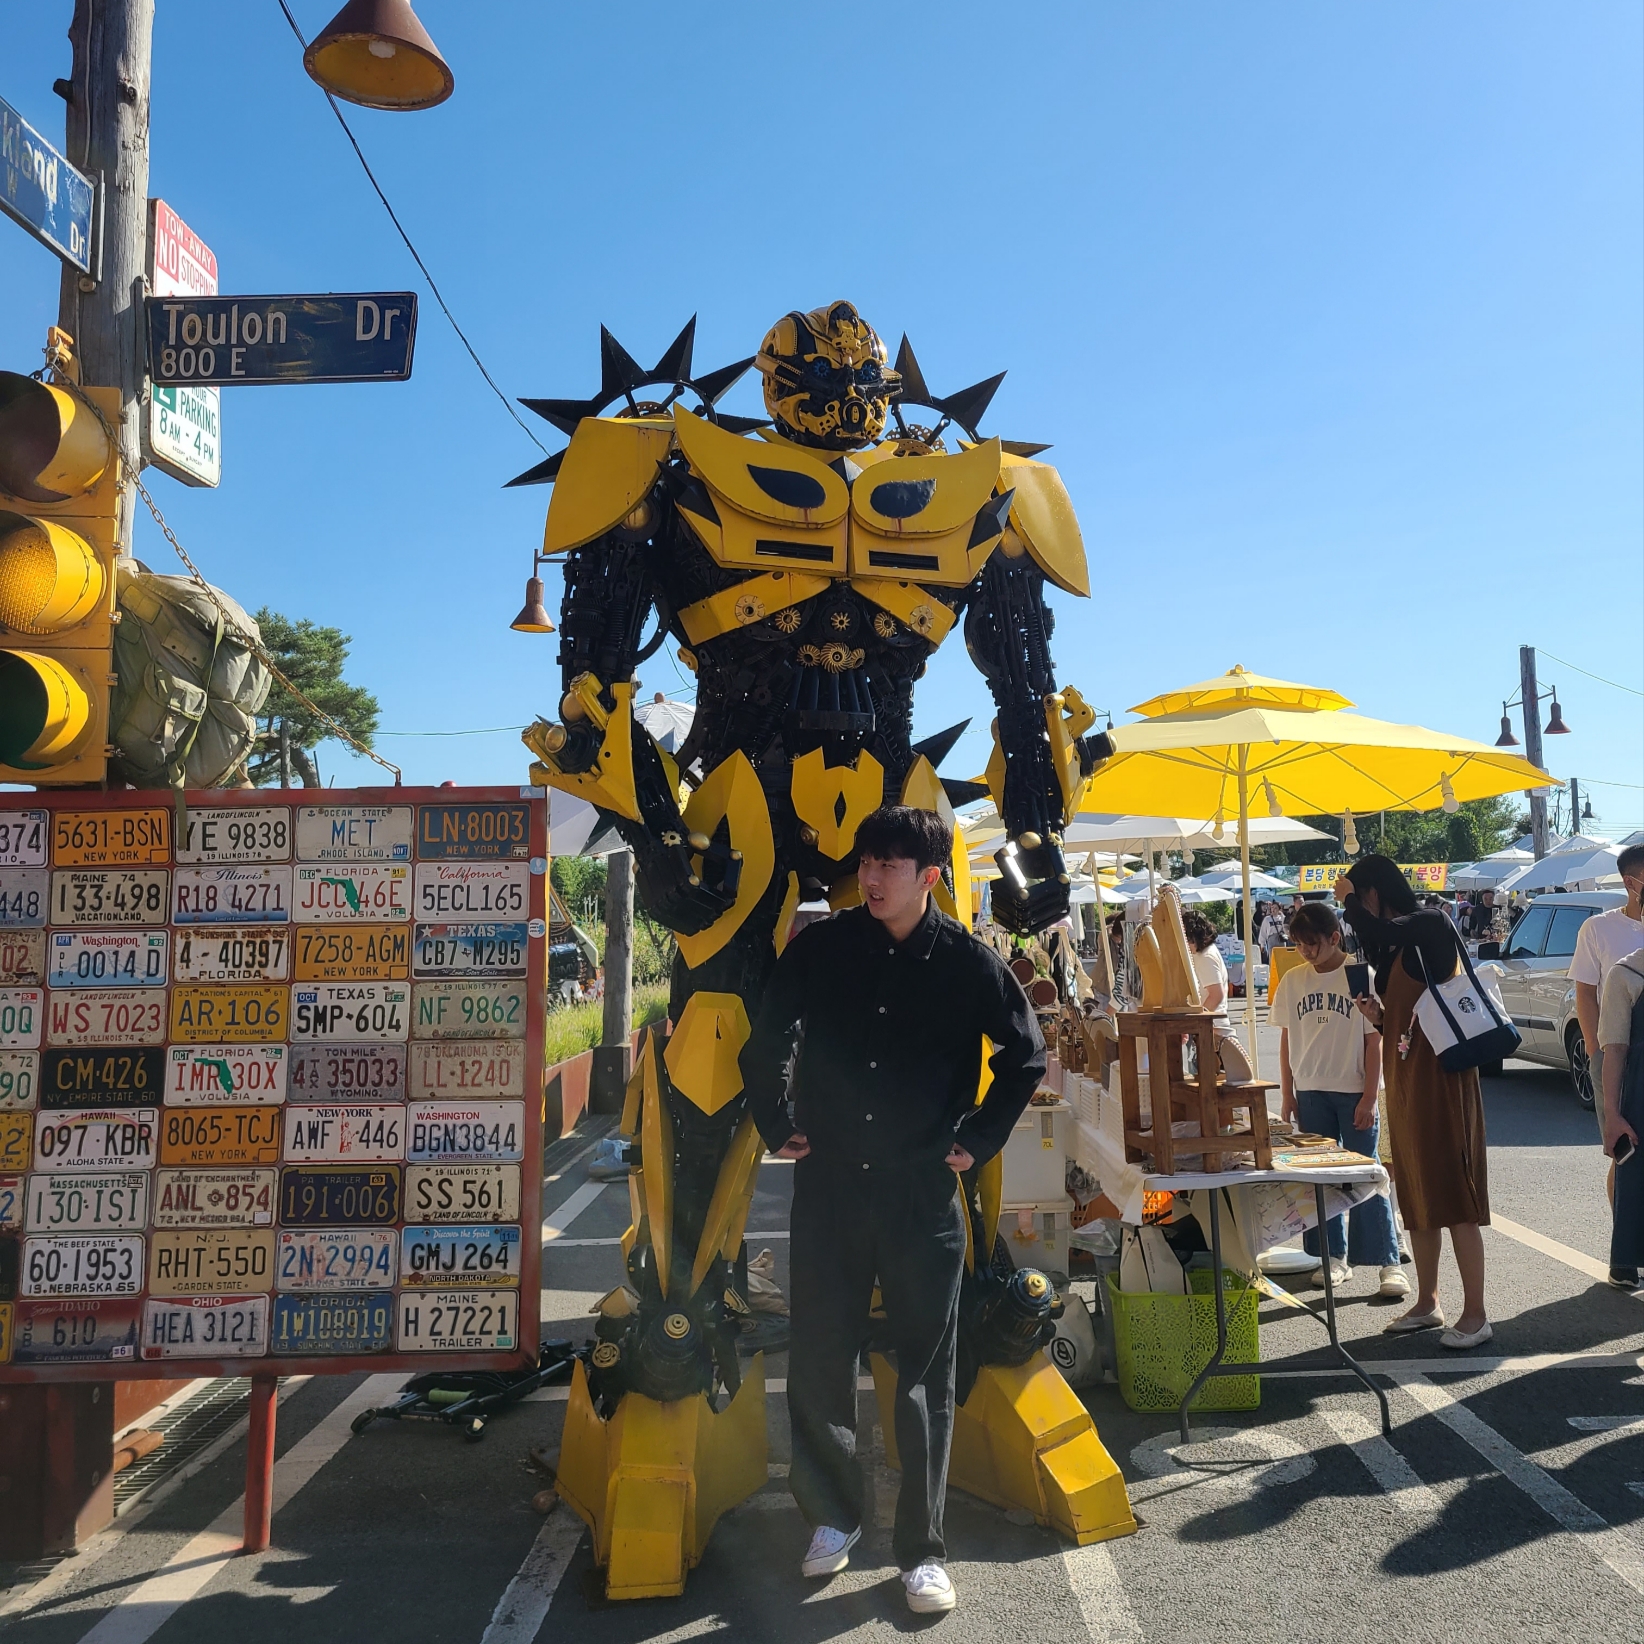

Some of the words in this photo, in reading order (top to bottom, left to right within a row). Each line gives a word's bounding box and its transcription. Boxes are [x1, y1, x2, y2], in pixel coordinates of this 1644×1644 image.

[0, 111, 57, 204] kland
[70, 221, 86, 259] Dr
[159, 229, 178, 275] NO
[163, 304, 286, 346] Toulon
[356, 301, 400, 341] Dr
[161, 349, 215, 377] 800
[231, 348, 246, 376] E
[180, 390, 216, 438] PARKING
[160, 408, 167, 434] 8
[169, 421, 180, 443] AM
[194, 431, 201, 456] 4
[204, 443, 213, 464] PM
[324, 809, 352, 817] OCEAN
[228, 821, 286, 849] 9838
[331, 820, 376, 846] MET
[84, 852, 107, 861] NEW
[113, 851, 139, 860] YORK
[321, 850, 347, 858] RHODE
[354, 849, 384, 858] ISLAND
[447, 845, 469, 854] NEW
[474, 845, 500, 853] YORK
[71, 874, 108, 882] MAINE
[121, 874, 135, 882] 74
[201, 869, 263, 881] Illinois
[326, 868, 379, 876] FLORIDA
[440, 867, 510, 883] California
[1416, 866, 1442, 881] 분양
[178, 885, 217, 913] R18
[231, 884, 284, 912] 4271
[423, 884, 522, 911] 5ECL165
[75, 913, 141, 921] VACATIONLAND
[447, 926, 496, 937] TEXAS
[82, 936, 140, 948] Washington
[301, 935, 405, 963] 7258-AGM
[219, 940, 283, 968] 40397
[473, 940, 520, 966] M295
[78, 950, 135, 978] 0014
[147, 950, 160, 977] D
[324, 968, 346, 976] NEW
[352, 967, 378, 976] YORK
[199, 970, 261, 979] FLORIDA
[327, 988, 375, 1000] TEXAS
[420, 996, 450, 1025] NF
[461, 995, 520, 1024] 9862
[1297, 993, 1324, 1020] CAPE
[1327, 993, 1354, 1019] MAY
[53, 1002, 90, 1034] WS
[101, 1004, 160, 1033] 7023
[200, 1049, 254, 1057] FLORIDA
[327, 1059, 398, 1087] 35033
[69, 1093, 102, 1102] EMPIRE
[106, 1092, 133, 1101] STATE
[316, 1109, 341, 1117] NEW
[345, 1109, 373, 1117] YORK
[416, 1112, 479, 1120] WASHINGTON
[168, 1115, 275, 1146] 8065-TCJ
[292, 1120, 333, 1149] AWF
[359, 1120, 398, 1149] 446
[413, 1123, 516, 1153] BGN3844
[41, 1125, 88, 1157] 097
[105, 1124, 152, 1156] KBR
[192, 1151, 214, 1159] NEW
[221, 1150, 246, 1159] YORK
[50, 1180, 127, 1189] MASSACHUSETTS
[325, 1176, 361, 1184] TRAILER
[160, 1184, 203, 1211] ANL
[225, 1184, 270, 1211] 854
[417, 1178, 454, 1209] SS
[462, 1180, 503, 1209] 561
[433, 1230, 459, 1238] Discover
[460, 1229, 470, 1237] the
[472, 1229, 490, 1238] Spirit
[411, 1243, 456, 1271] GMJ
[462, 1243, 508, 1270] 264
[49, 1284, 112, 1293] NEBRASKA
[177, 1283, 213, 1291] GARDEN
[59, 1301, 100, 1311] IDAHO
[192, 1298, 222, 1307] OHIO
[301, 1298, 366, 1306] FLORIDA
[437, 1294, 479, 1303] MAINE
[152, 1313, 194, 1343] HEA
[203, 1311, 257, 1342] 3121
[404, 1307, 419, 1336] H
[429, 1306, 507, 1336] 27221
[431, 1338, 483, 1347] TRAILER
